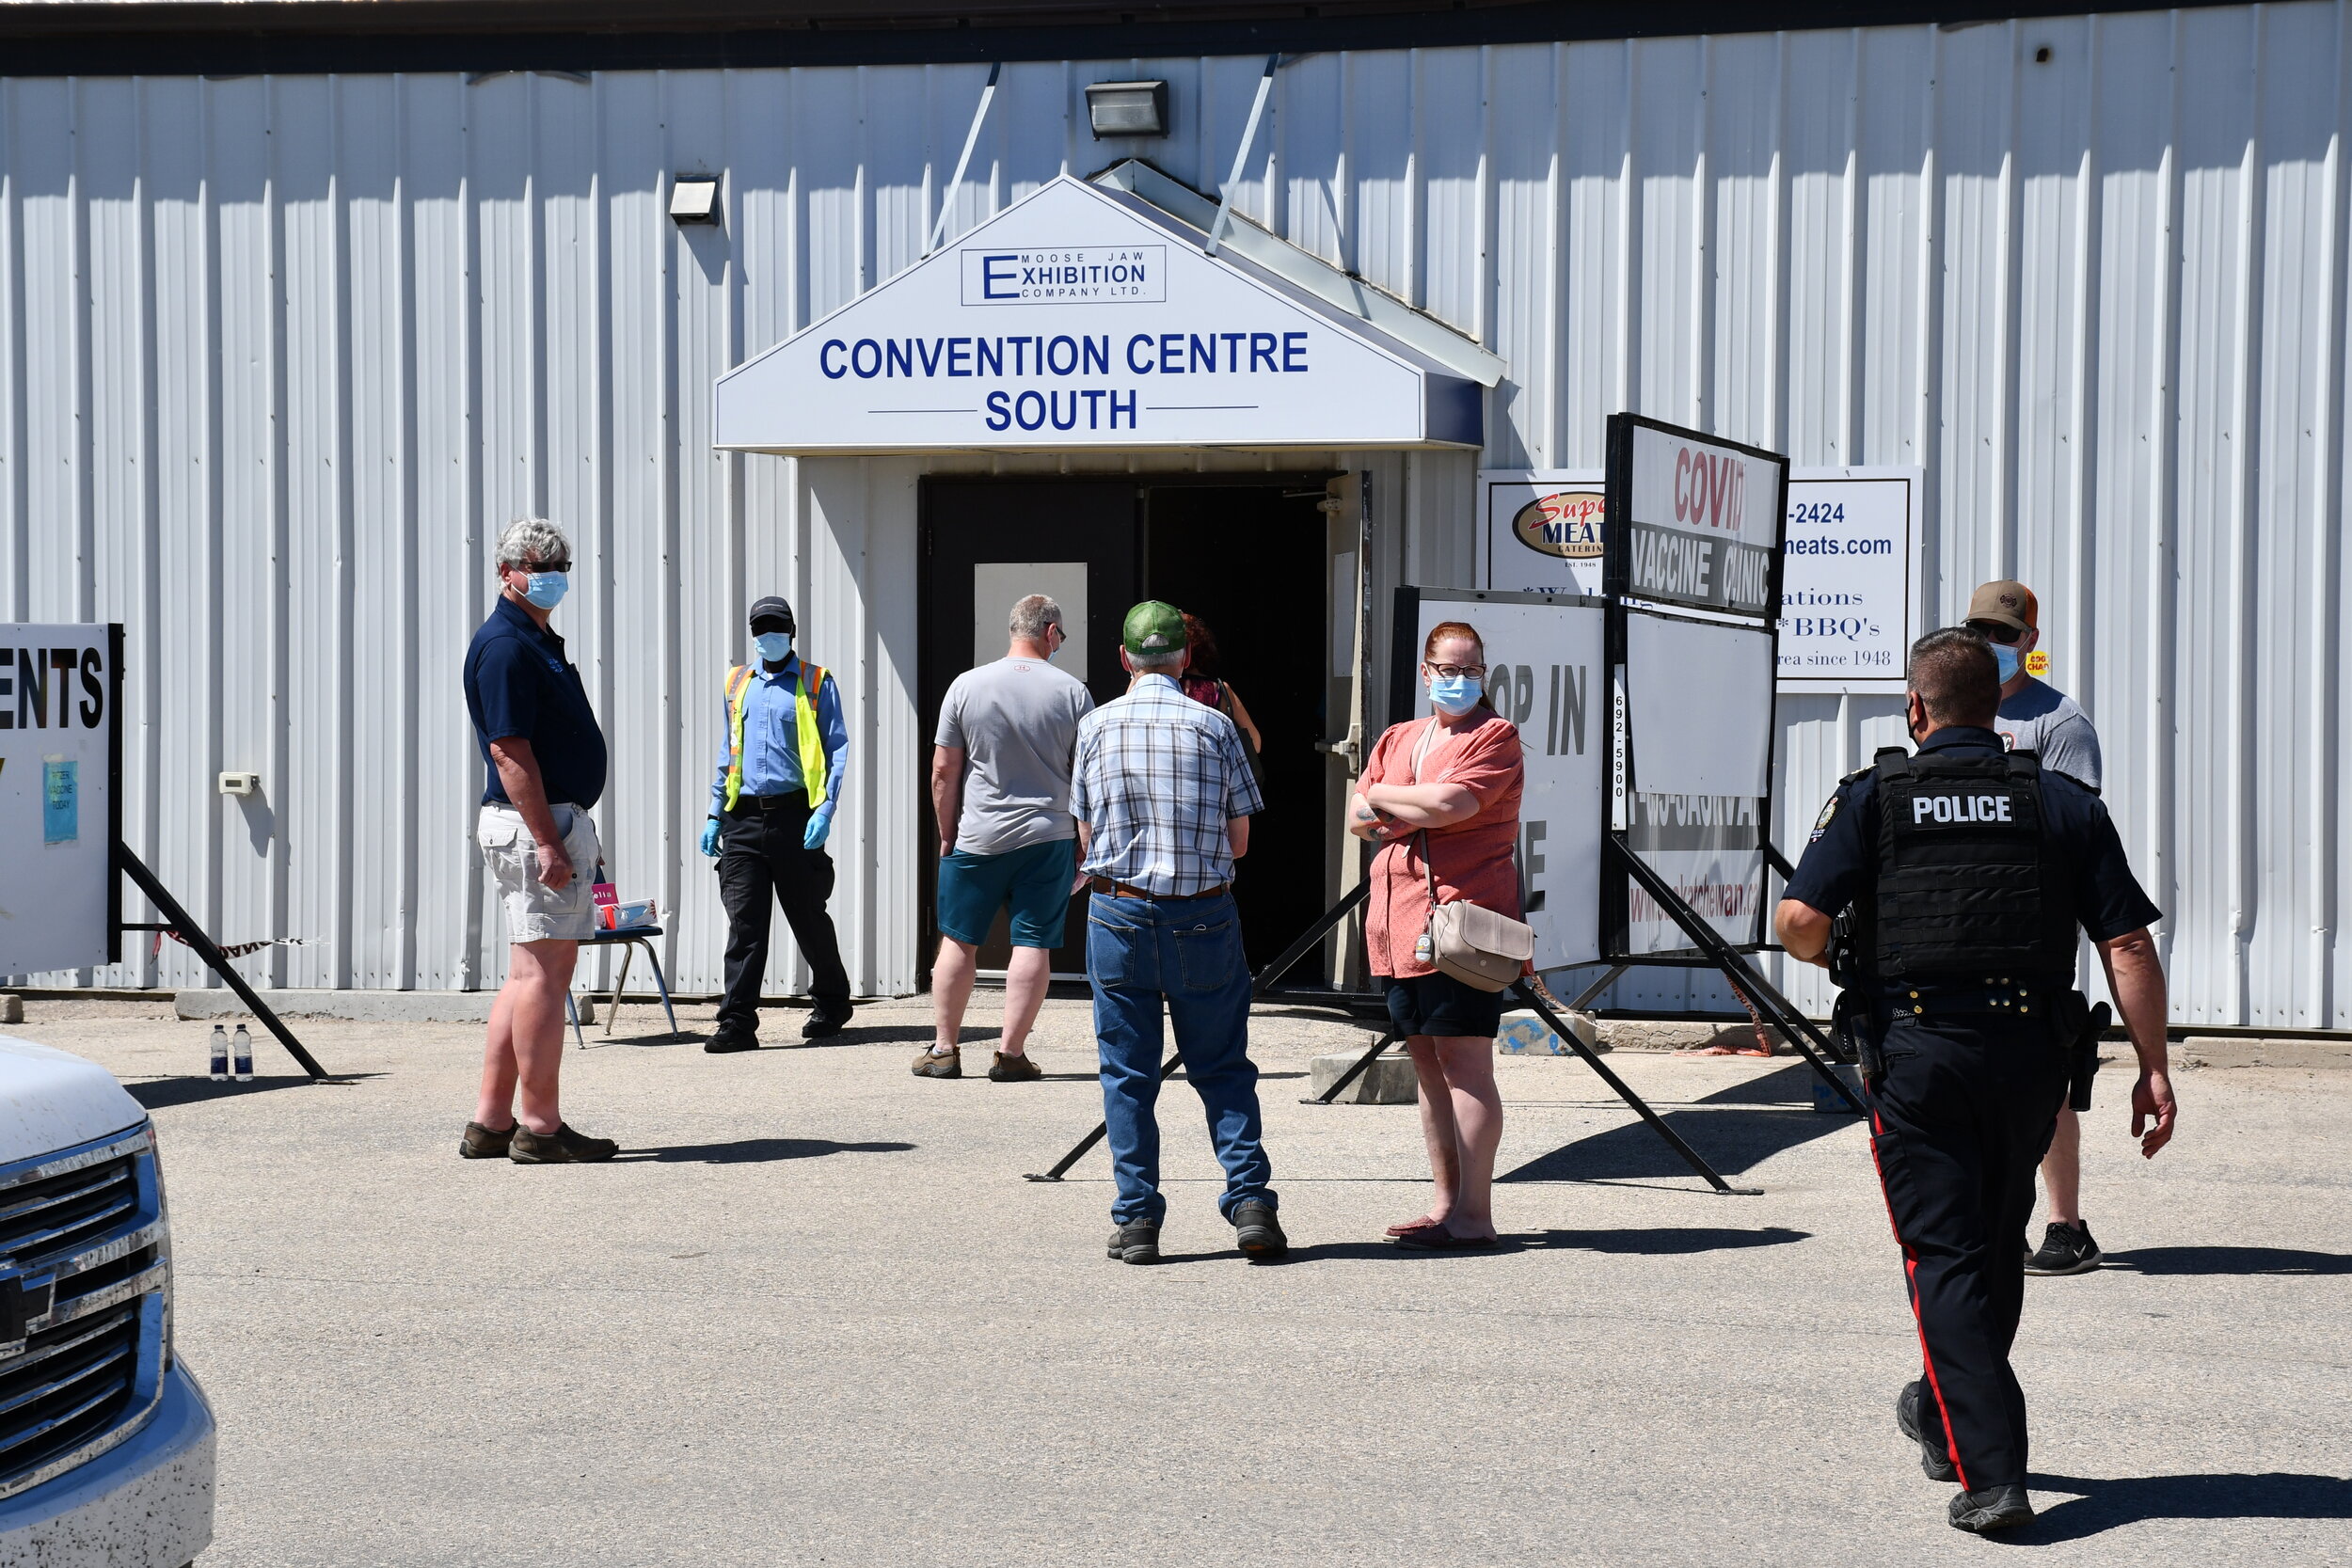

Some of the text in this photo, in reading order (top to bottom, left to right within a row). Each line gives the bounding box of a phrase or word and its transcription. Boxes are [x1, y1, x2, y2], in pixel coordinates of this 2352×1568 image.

[1021, 251, 1144, 263] MOOSE JAW
[983, 255, 1145, 299] EXHIBITION
[1022, 286, 1146, 298] COMPANY LTD.
[818, 331, 1309, 380] CONVENTION CENTRE
[984, 389, 1138, 432] SOUTH
[1788, 502, 1844, 523] -2424
[1631, 528, 1770, 606] VACCINE CLINIC
[1807, 650, 1847, 666] since
[1853, 650, 1891, 666] 1948
[1547, 664, 1587, 755] IN
[1914, 795, 2012, 825] POLICE
